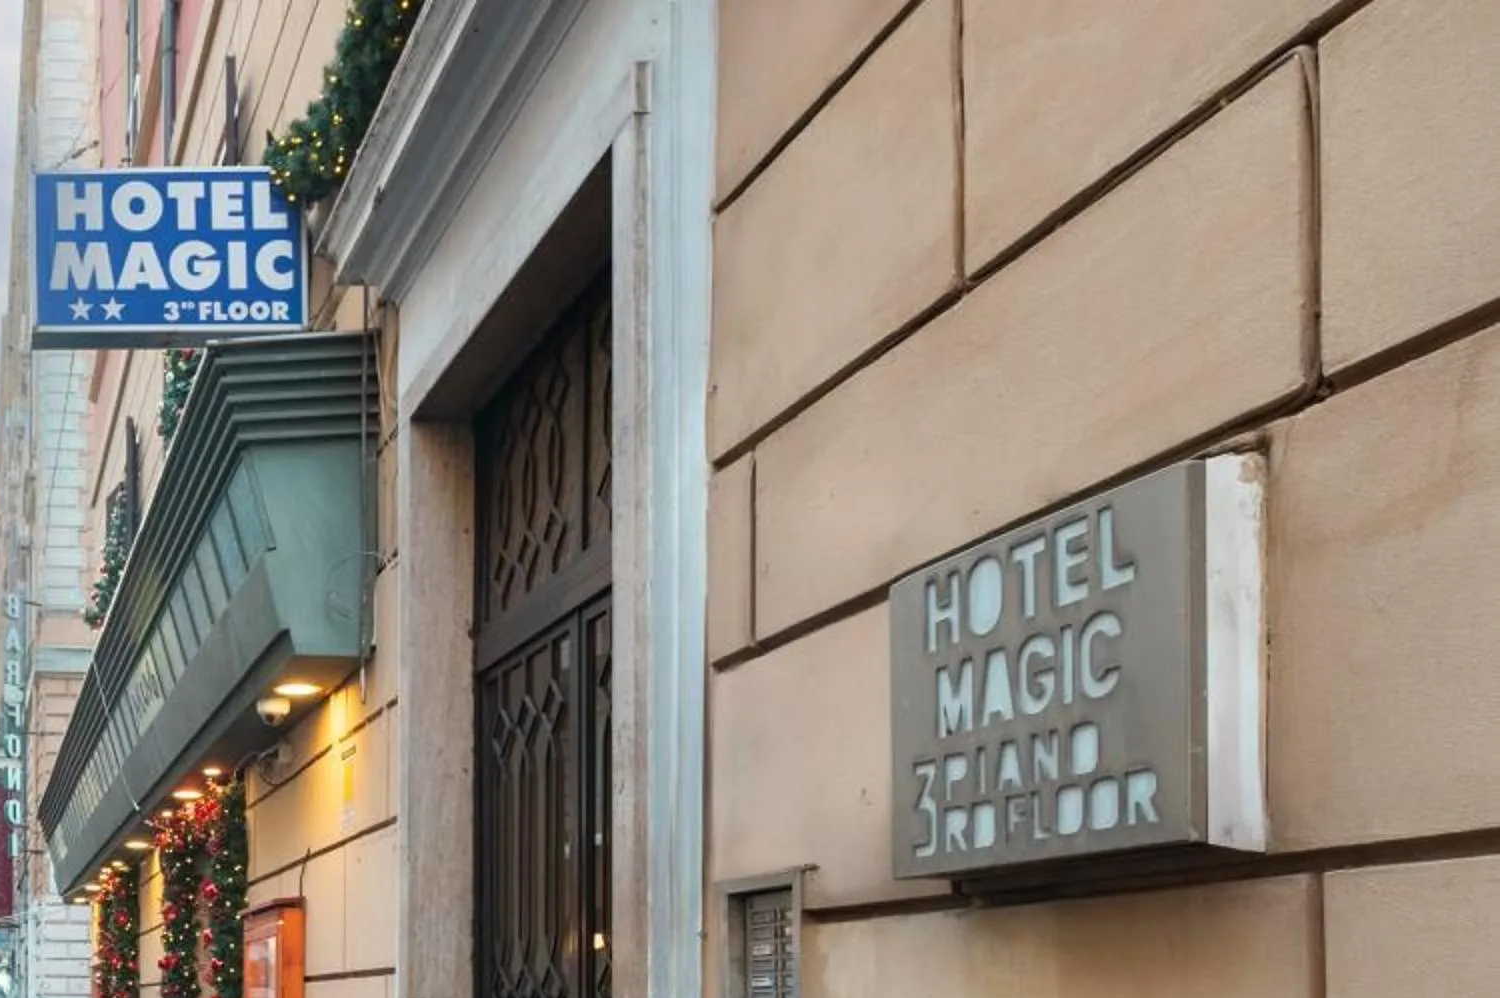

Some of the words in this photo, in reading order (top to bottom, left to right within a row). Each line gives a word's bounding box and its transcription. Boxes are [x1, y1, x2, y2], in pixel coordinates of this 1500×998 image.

[56, 181, 289, 231] HOTEL
[50, 240, 294, 291] MAGIC
[199, 301, 290, 321] FLOOR
[925, 505, 1136, 653] HOTEL
[935, 609, 1122, 739] MAGIC
[944, 721, 1099, 801] PIANO
[1005, 767, 1160, 846] FLOOR
